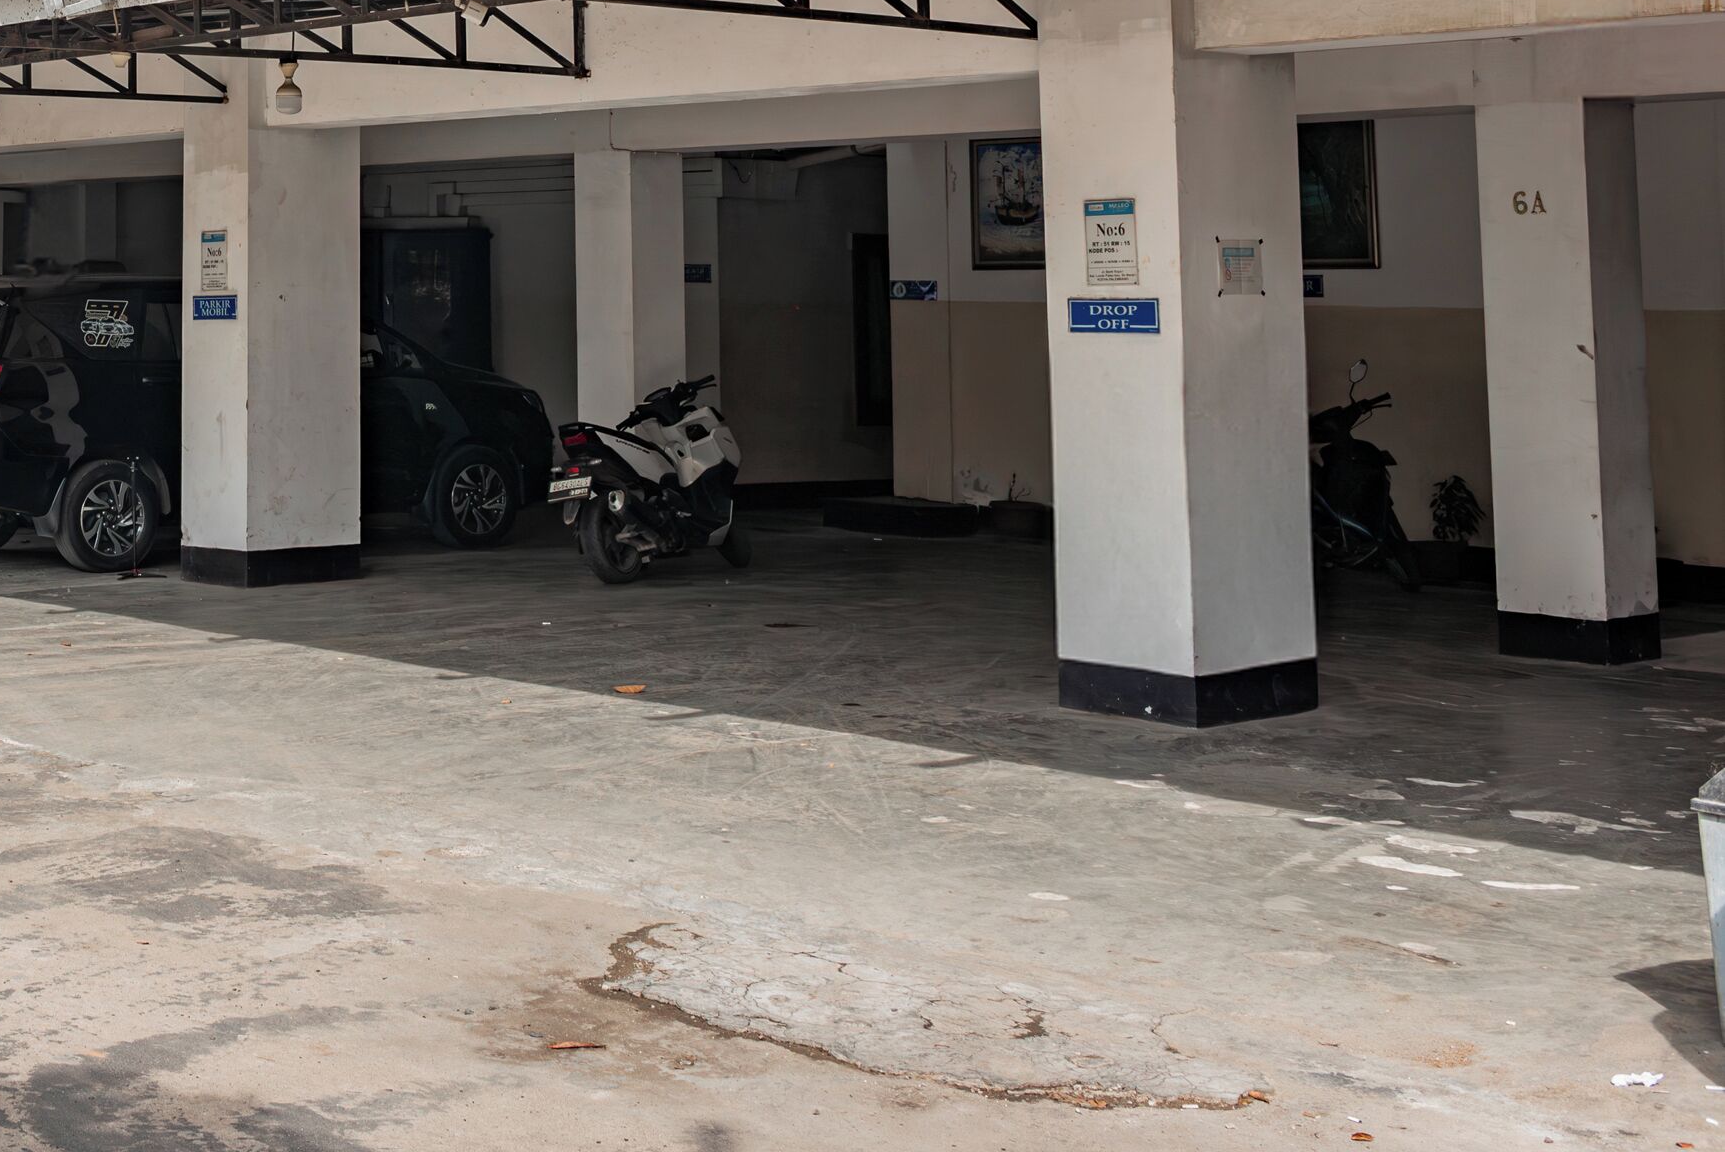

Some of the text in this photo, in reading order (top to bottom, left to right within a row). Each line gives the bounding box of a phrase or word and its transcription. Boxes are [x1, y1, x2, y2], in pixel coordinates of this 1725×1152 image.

[1512, 190, 1547, 215] 6A
[1096, 222, 1126, 237] No:6
[207, 247, 222, 257] No:6
[199, 299, 231, 308] PARKIR
[201, 308, 230, 317] MOBIL
[1089, 305, 1138, 316] DROP
[1097, 319, 1130, 330] OFF
